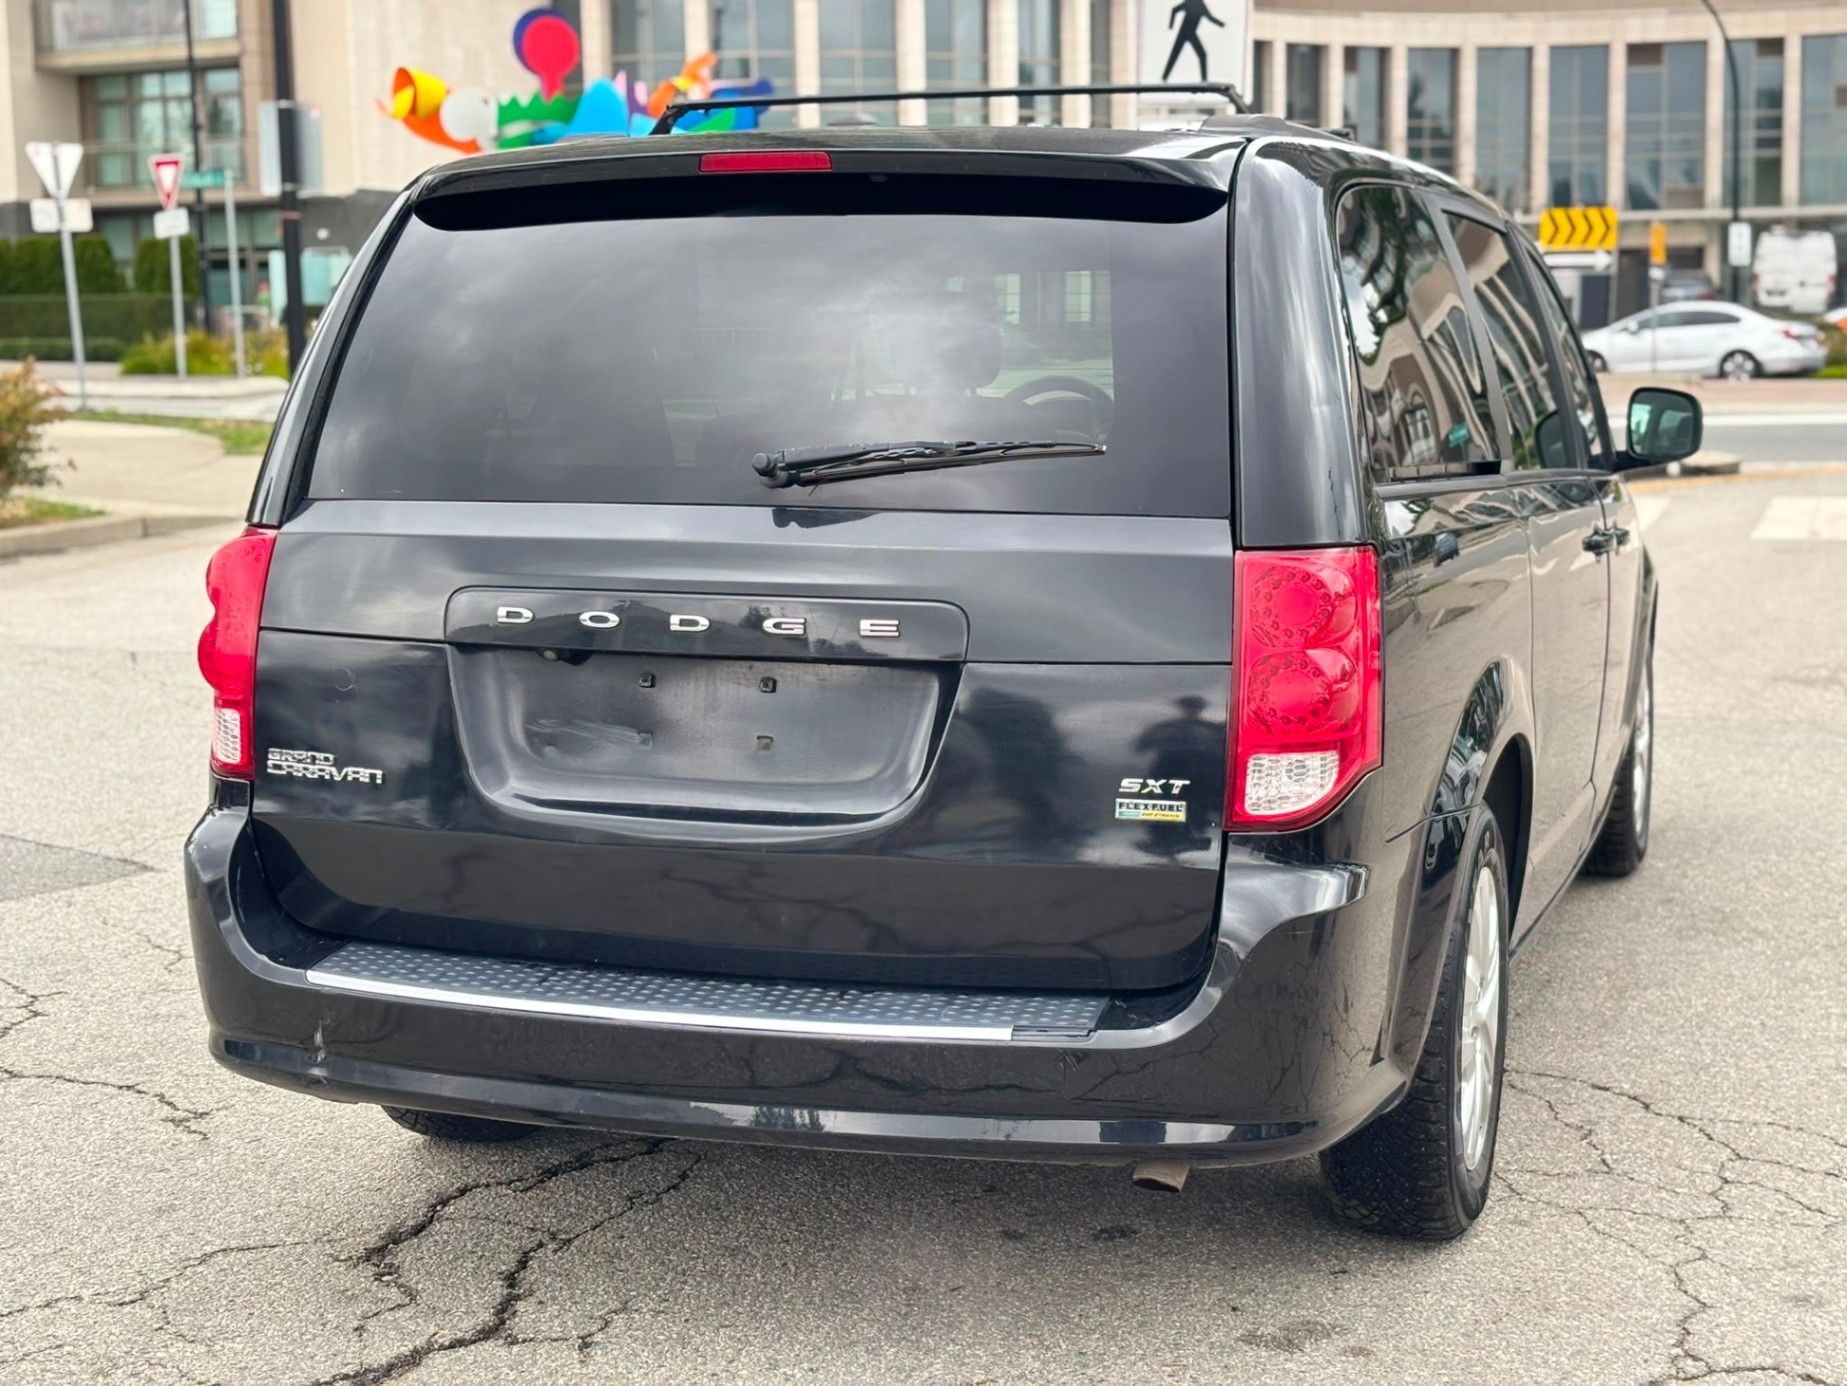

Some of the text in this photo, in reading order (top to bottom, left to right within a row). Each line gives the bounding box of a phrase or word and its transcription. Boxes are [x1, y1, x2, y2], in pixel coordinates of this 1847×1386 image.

[496, 606, 900, 638] DODGE
[267, 747, 334, 766] GRAND
[266, 759, 384, 784] CARAVAN
[1118, 777, 1191, 795] SXT
